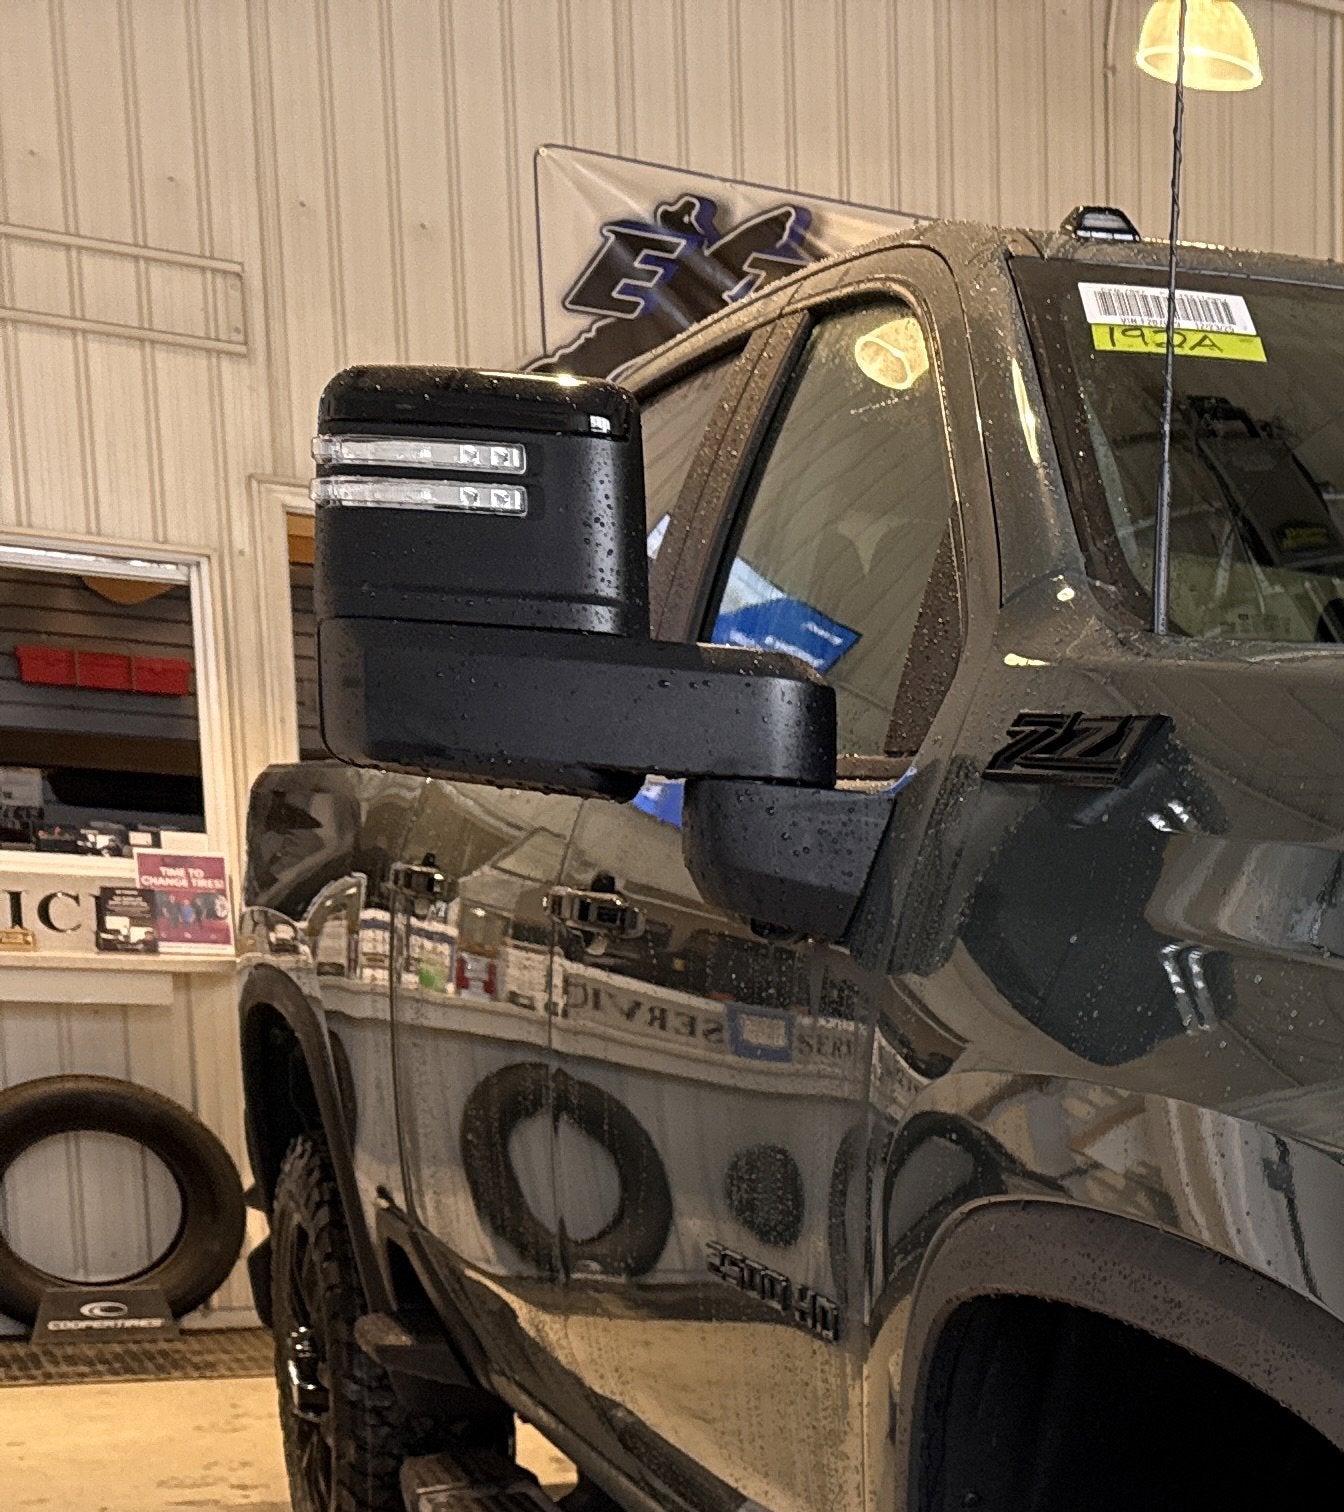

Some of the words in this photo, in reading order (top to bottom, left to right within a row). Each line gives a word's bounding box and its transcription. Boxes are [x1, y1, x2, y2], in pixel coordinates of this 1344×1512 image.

[1108, 326, 1224, 353] 192A
[980, 711, 1174, 789] Z71
[140, 875, 188, 889] CHANGE
[160, 866, 186, 877] TIME
[188, 867, 205, 879] TO
